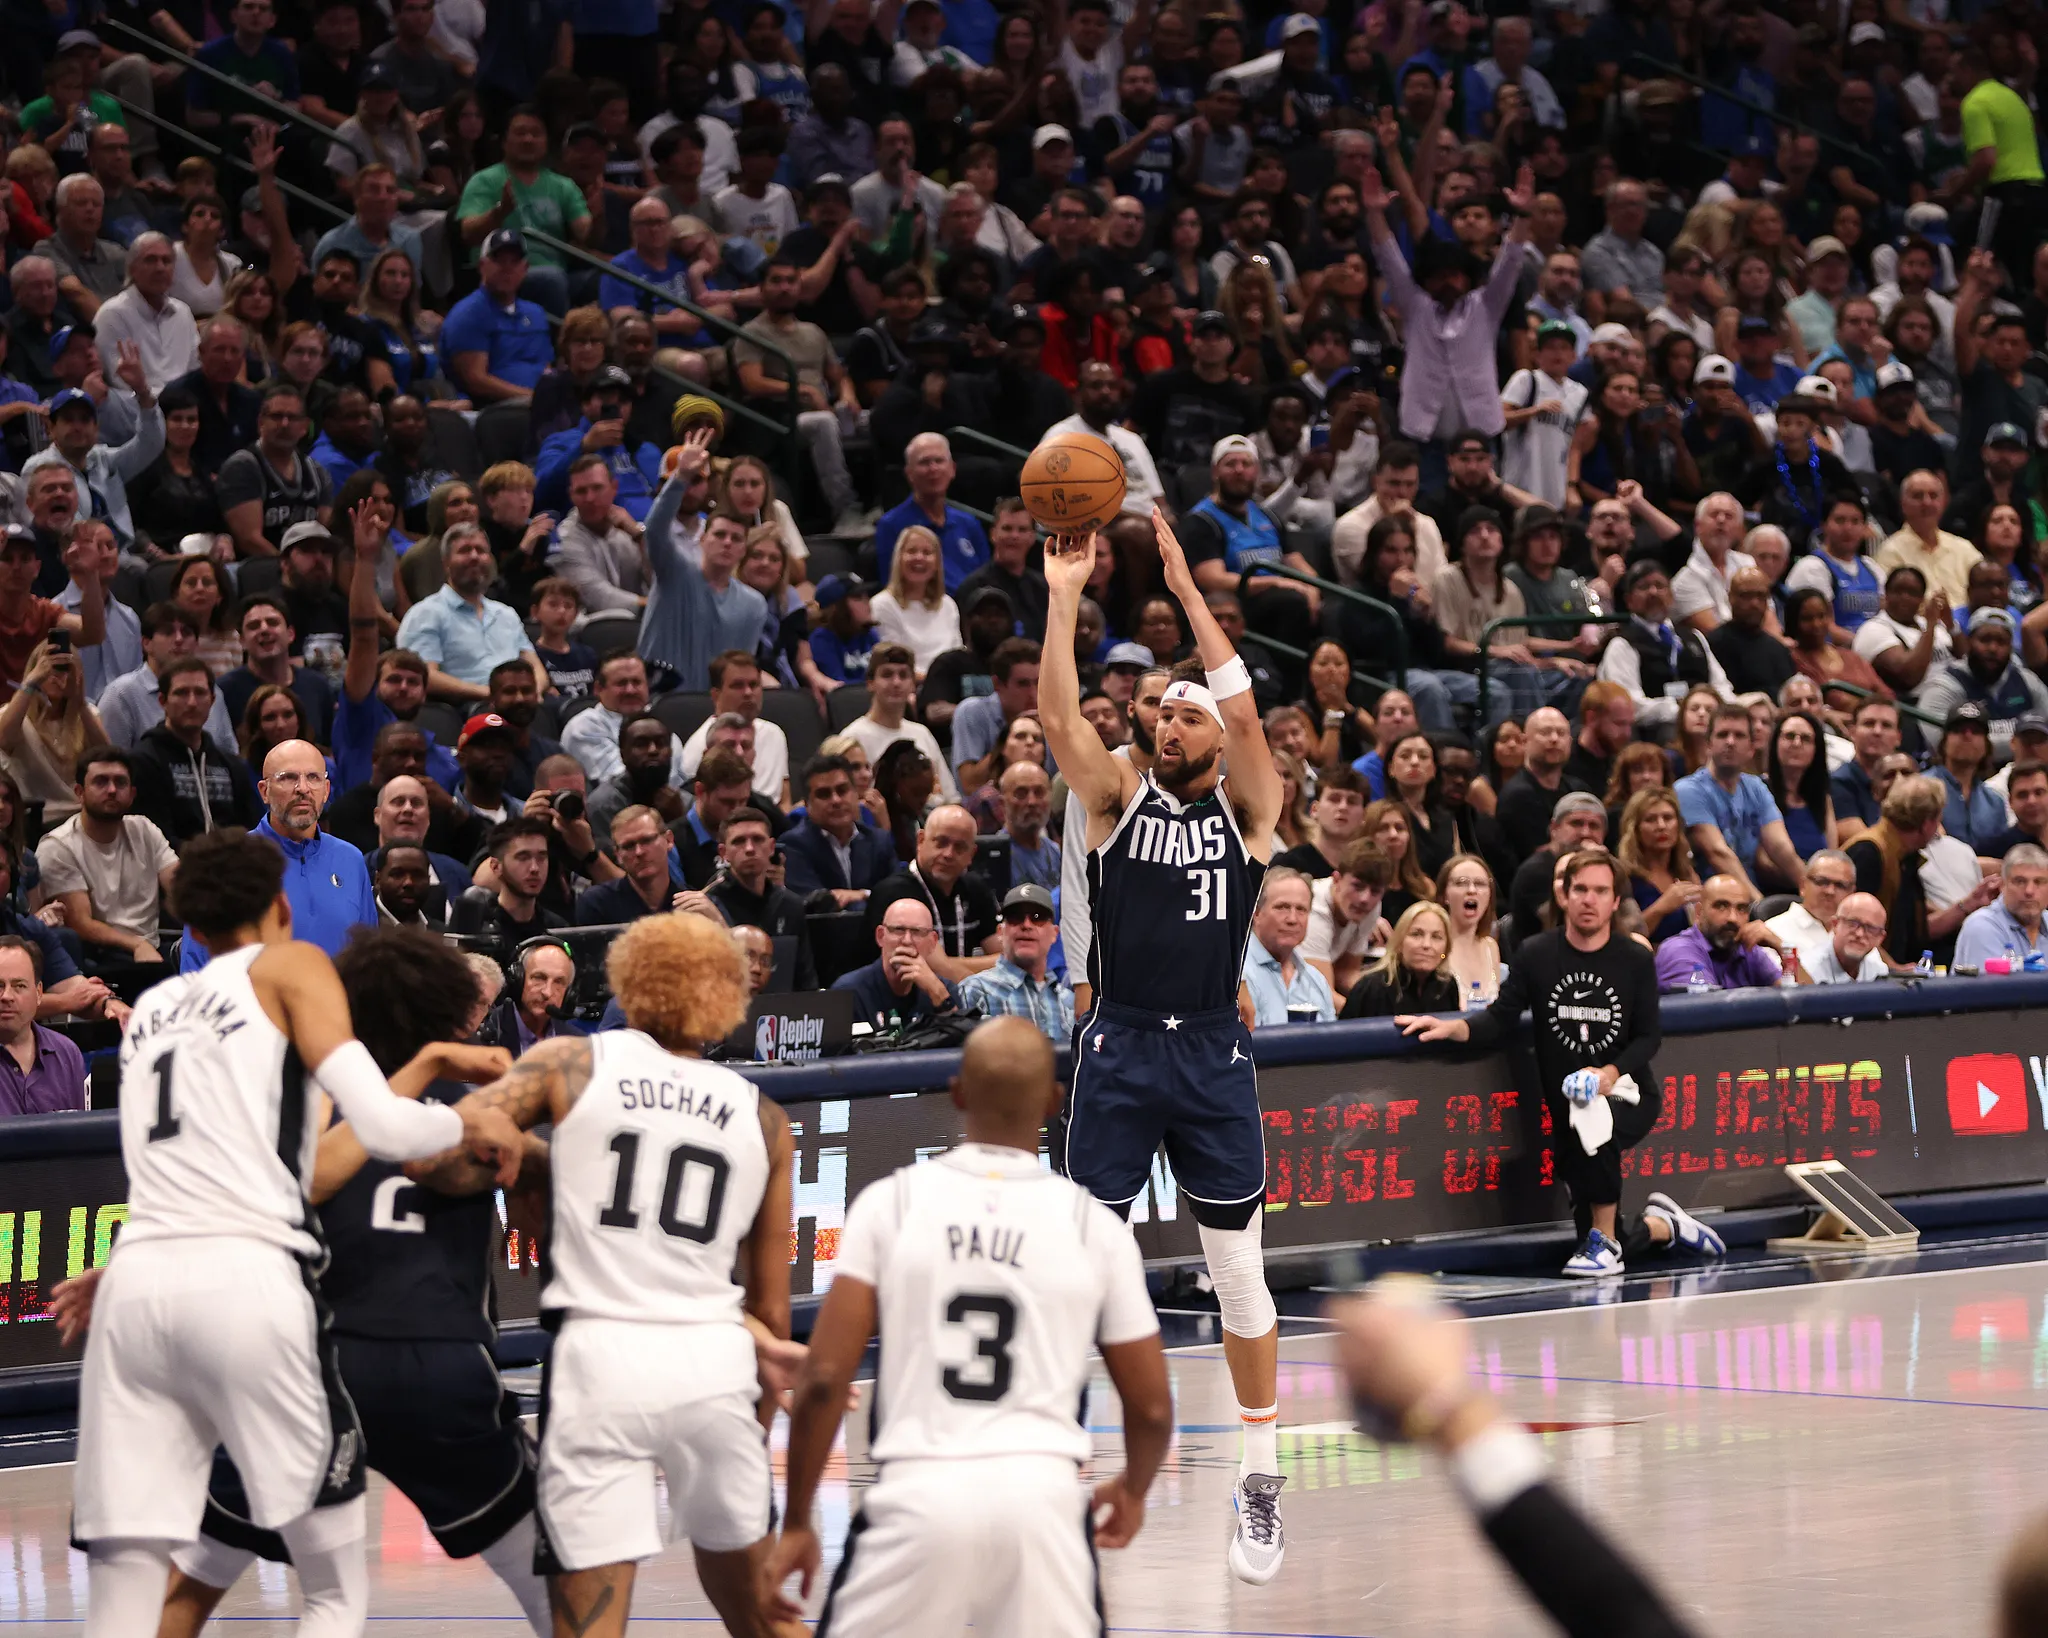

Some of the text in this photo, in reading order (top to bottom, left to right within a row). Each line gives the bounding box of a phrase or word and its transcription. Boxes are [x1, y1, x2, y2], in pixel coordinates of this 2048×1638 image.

[1128, 814, 1227, 868] MAVS
[1185, 868, 1228, 922] 31
[778, 1013, 824, 1049] Replay
[148, 1046, 182, 1144] 1
[617, 1078, 736, 1132] SOCHAN
[599, 1129, 732, 1246] 10
[946, 1224, 1024, 1269] PAUL
[941, 1293, 1017, 1403] 3
